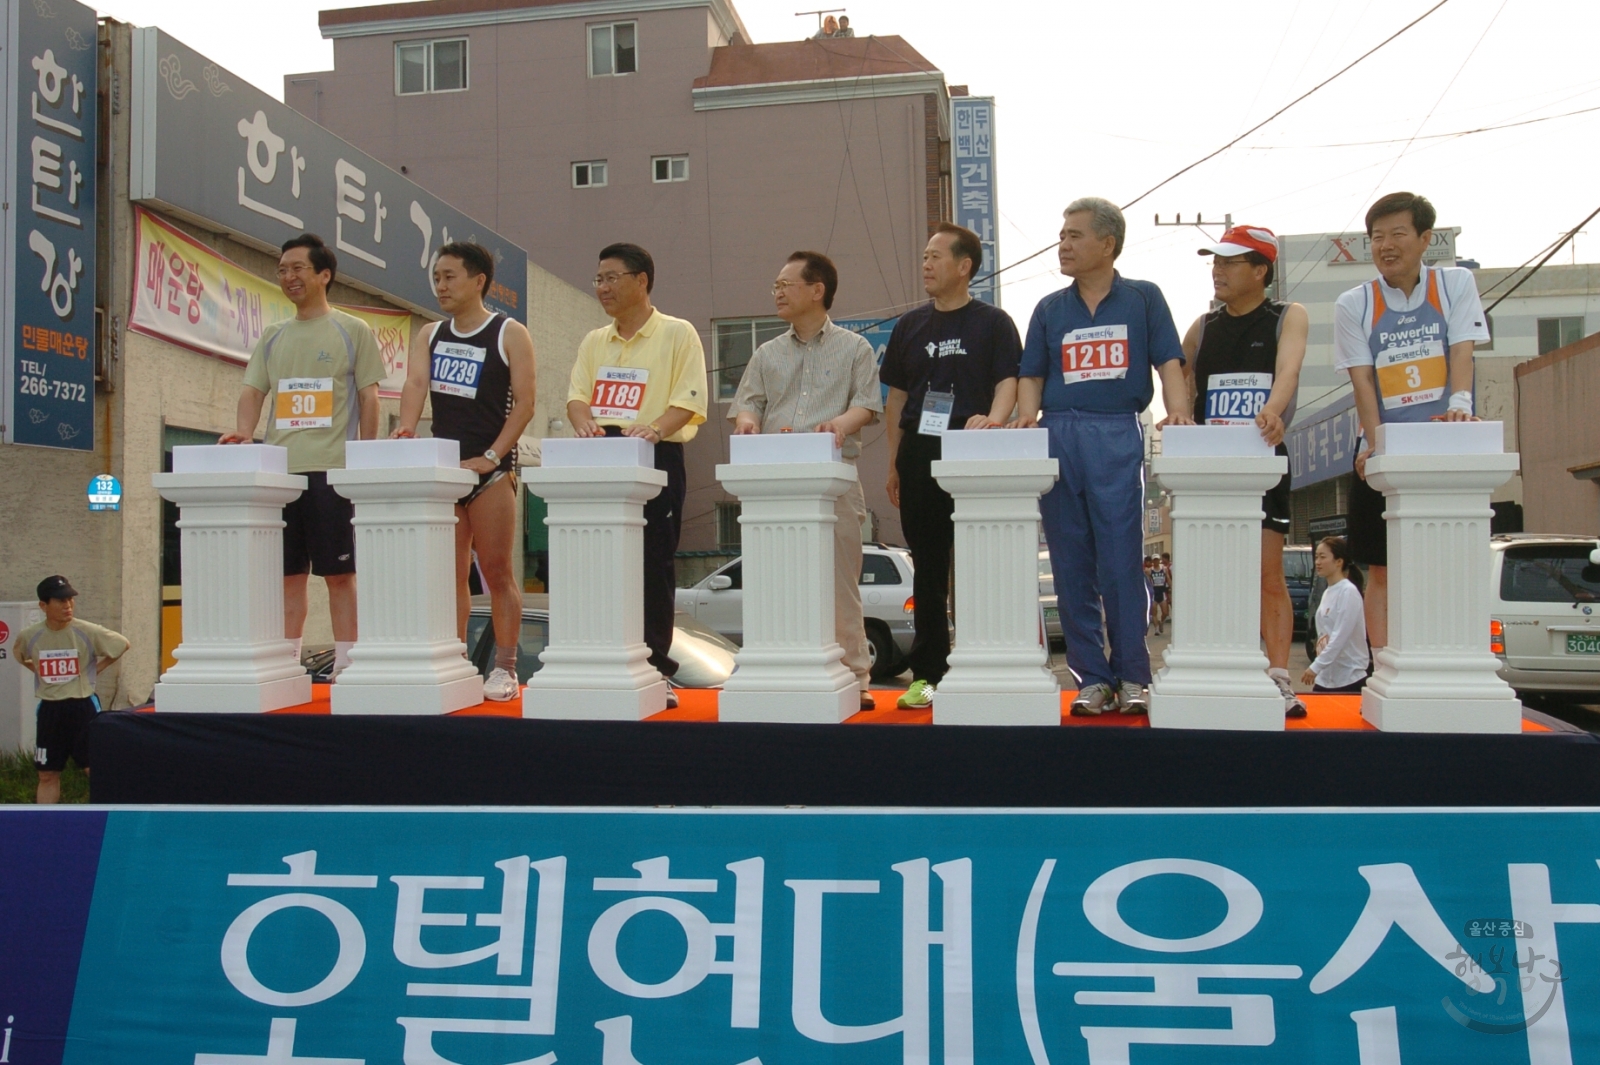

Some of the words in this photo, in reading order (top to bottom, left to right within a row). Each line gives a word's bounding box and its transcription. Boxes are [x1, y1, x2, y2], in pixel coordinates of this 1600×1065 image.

[29, 49, 84, 317] 한탄강
[147, 241, 204, 325] 매운탕
[22, 325, 89, 360] 민물매운탕
[1380, 323, 1440, 344] Powerfull
[1066, 343, 1124, 369] 1218
[434, 357, 478, 385] 10239
[1081, 371, 1091, 379] SK
[1405, 365, 1421, 388] 3
[20, 375, 86, 402] 266-7372
[595, 383, 641, 407] 1189
[1401, 396, 1414, 404] SK
[292, 394, 316, 415] 30
[1209, 391, 1266, 416] 10238
[96, 481, 113, 491] 132
[41, 659, 77, 676] 1184
